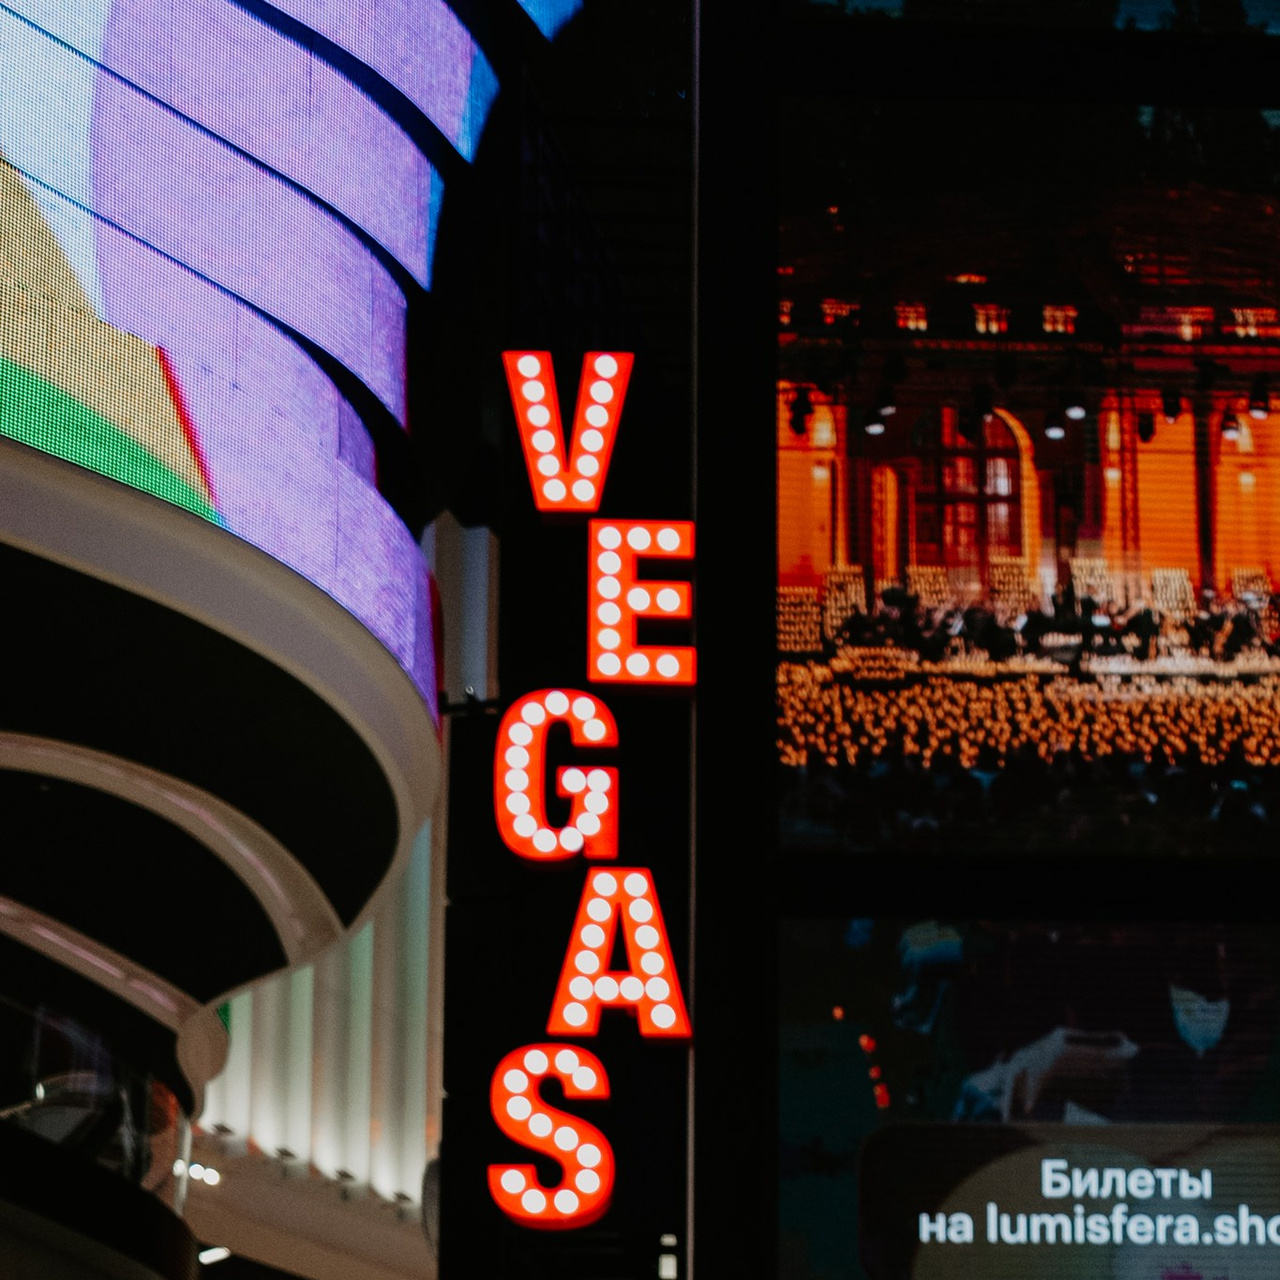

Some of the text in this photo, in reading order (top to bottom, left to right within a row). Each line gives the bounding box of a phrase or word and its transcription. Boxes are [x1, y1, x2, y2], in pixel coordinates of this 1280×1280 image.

[487, 351, 697, 1230] VEGAS
[1041, 1159, 1212, 1199] Билеты
[919, 1213, 974, 1243] на
